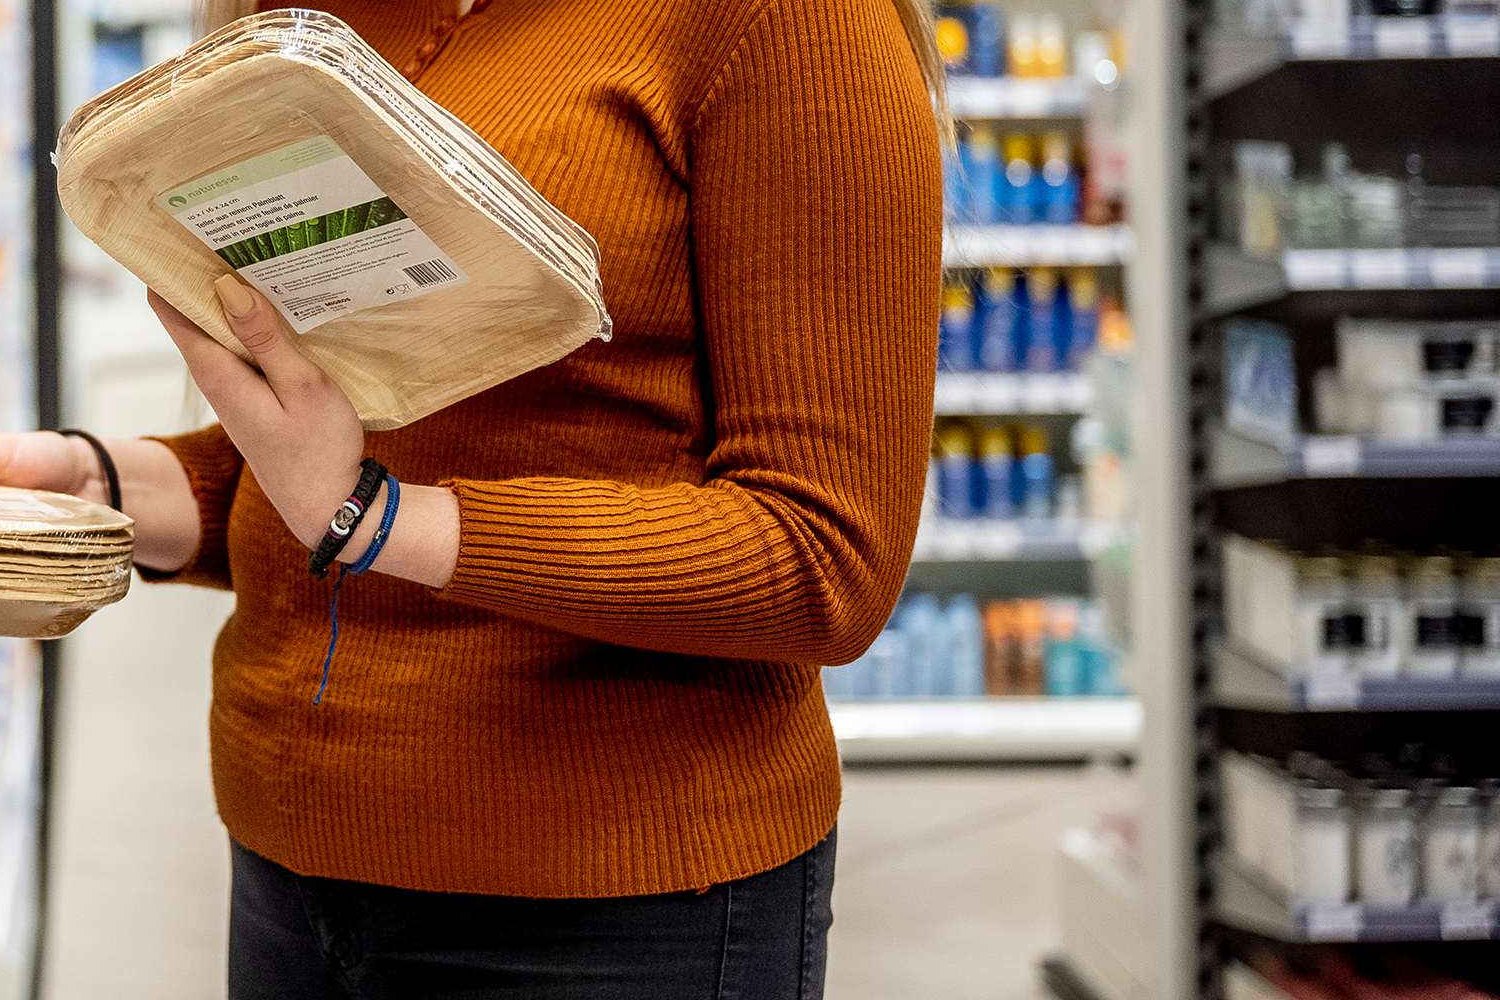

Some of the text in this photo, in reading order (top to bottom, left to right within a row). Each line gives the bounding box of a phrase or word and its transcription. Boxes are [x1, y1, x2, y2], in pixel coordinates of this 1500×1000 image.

[188, 175, 239, 198] naturesse
[195, 219, 215, 228] Teller
[228, 205, 253, 216] reinem
[252, 194, 285, 208] Palmblatt
[205, 222, 236, 236] Assiettes
[245, 213, 262, 222] pure
[261, 206, 283, 215] feuille
[293, 195, 318, 207] palmier
[212, 234, 232, 243] Piatti
[239, 226, 255, 235] pure
[254, 220, 275, 228] foglie
[283, 211, 304, 221] palma
[324, 297, 351, 306] MIGROS
